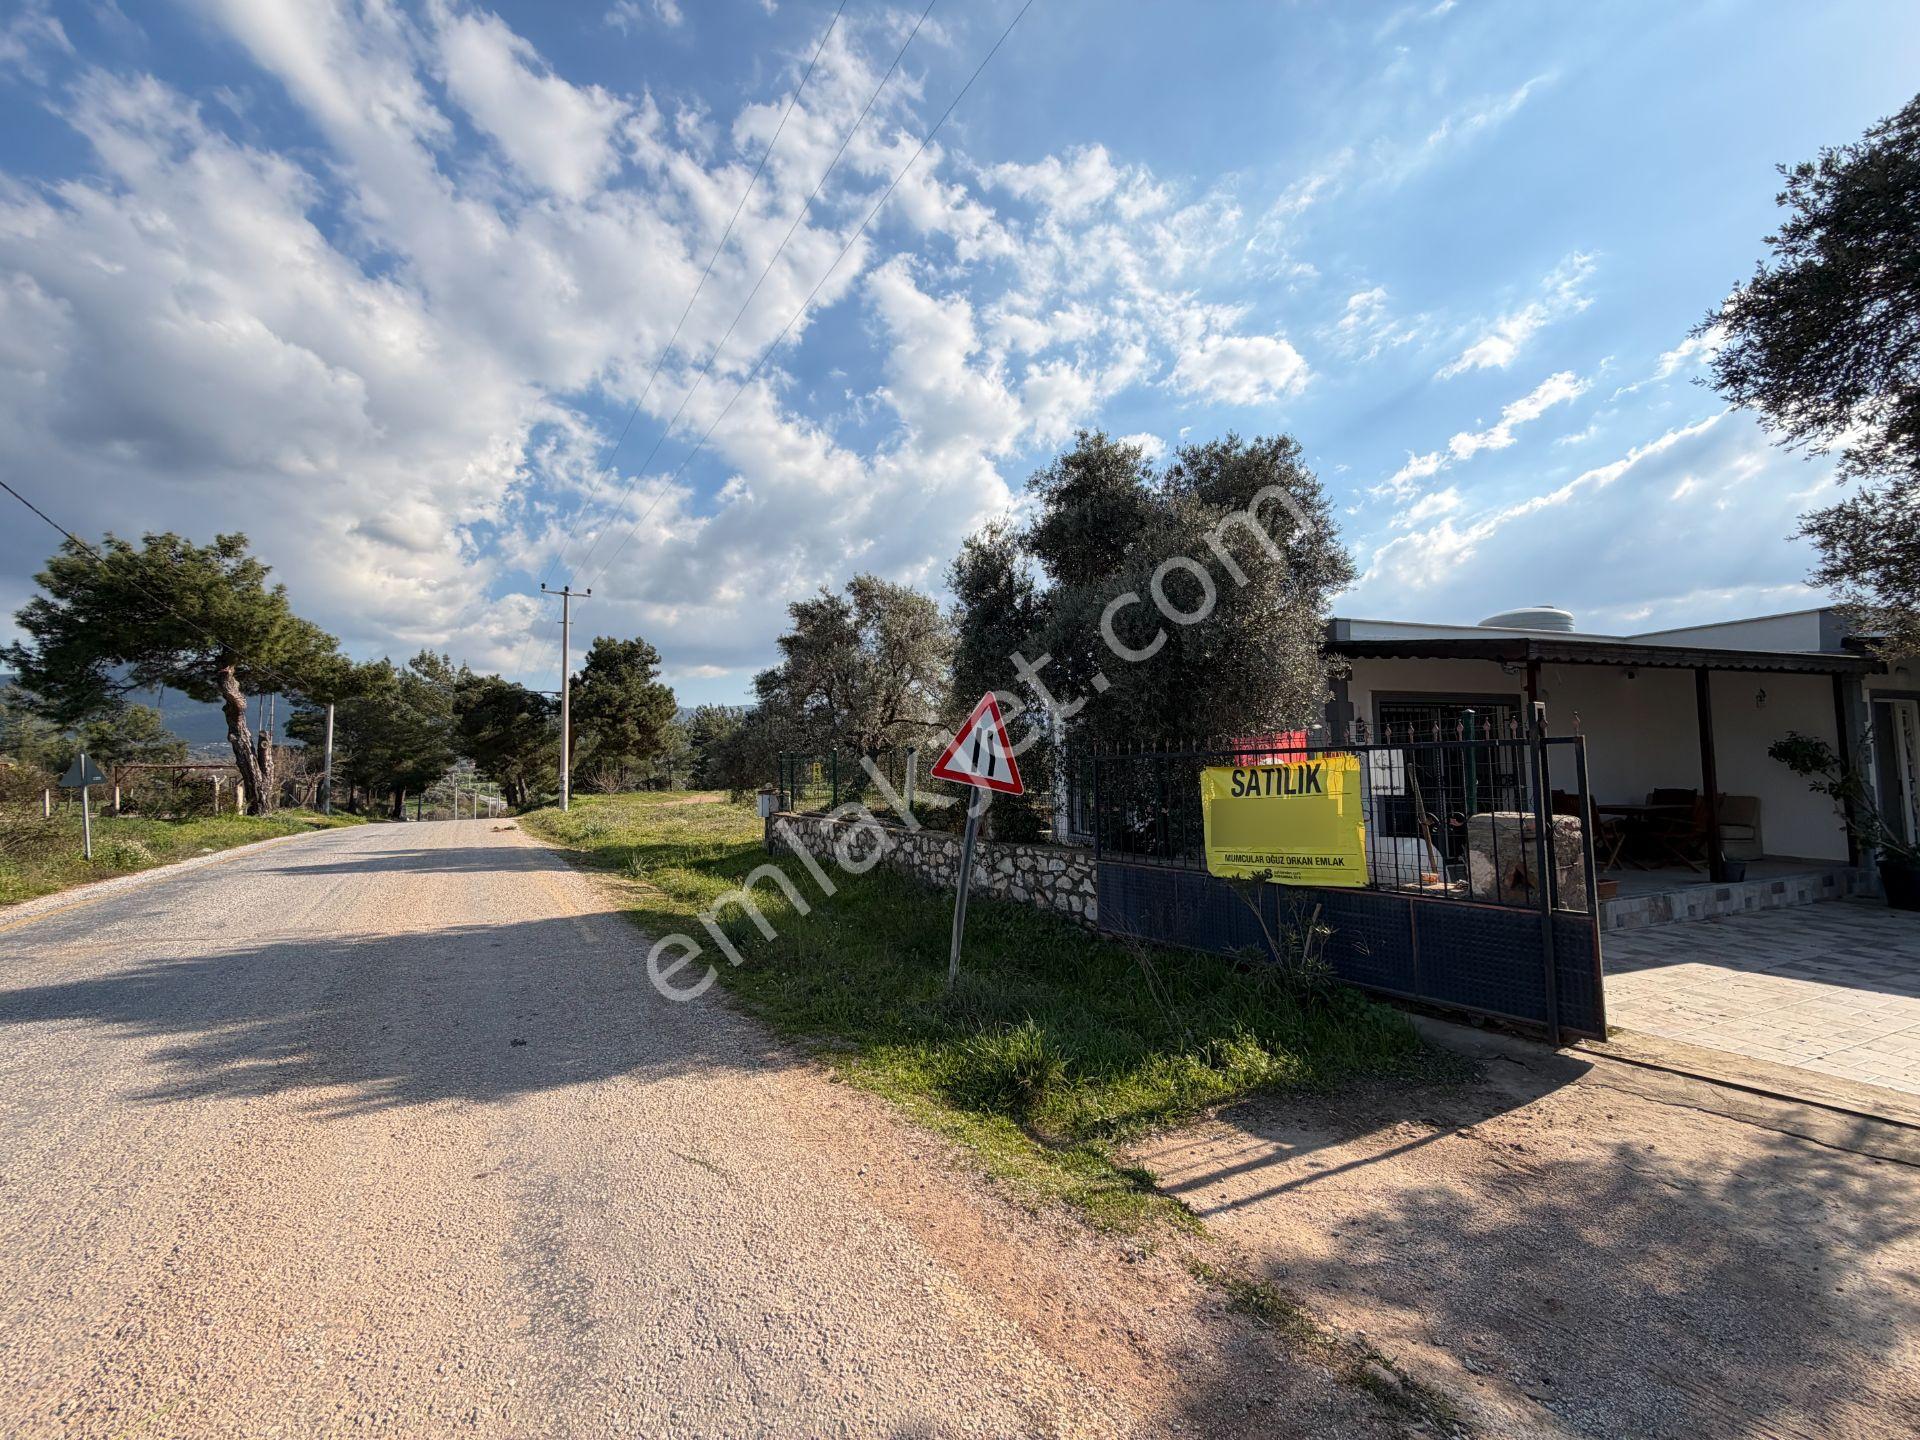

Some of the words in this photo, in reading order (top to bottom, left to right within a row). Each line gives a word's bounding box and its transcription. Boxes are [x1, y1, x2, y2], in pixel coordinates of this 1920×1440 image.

[1231, 764, 1322, 797] SATILIK
[1224, 854, 1264, 864] MUMCULAR
[1266, 855, 1285, 864] OĞUZ
[1286, 856, 1313, 865] ORKAN
[1315, 857, 1345, 866] EMLAK
